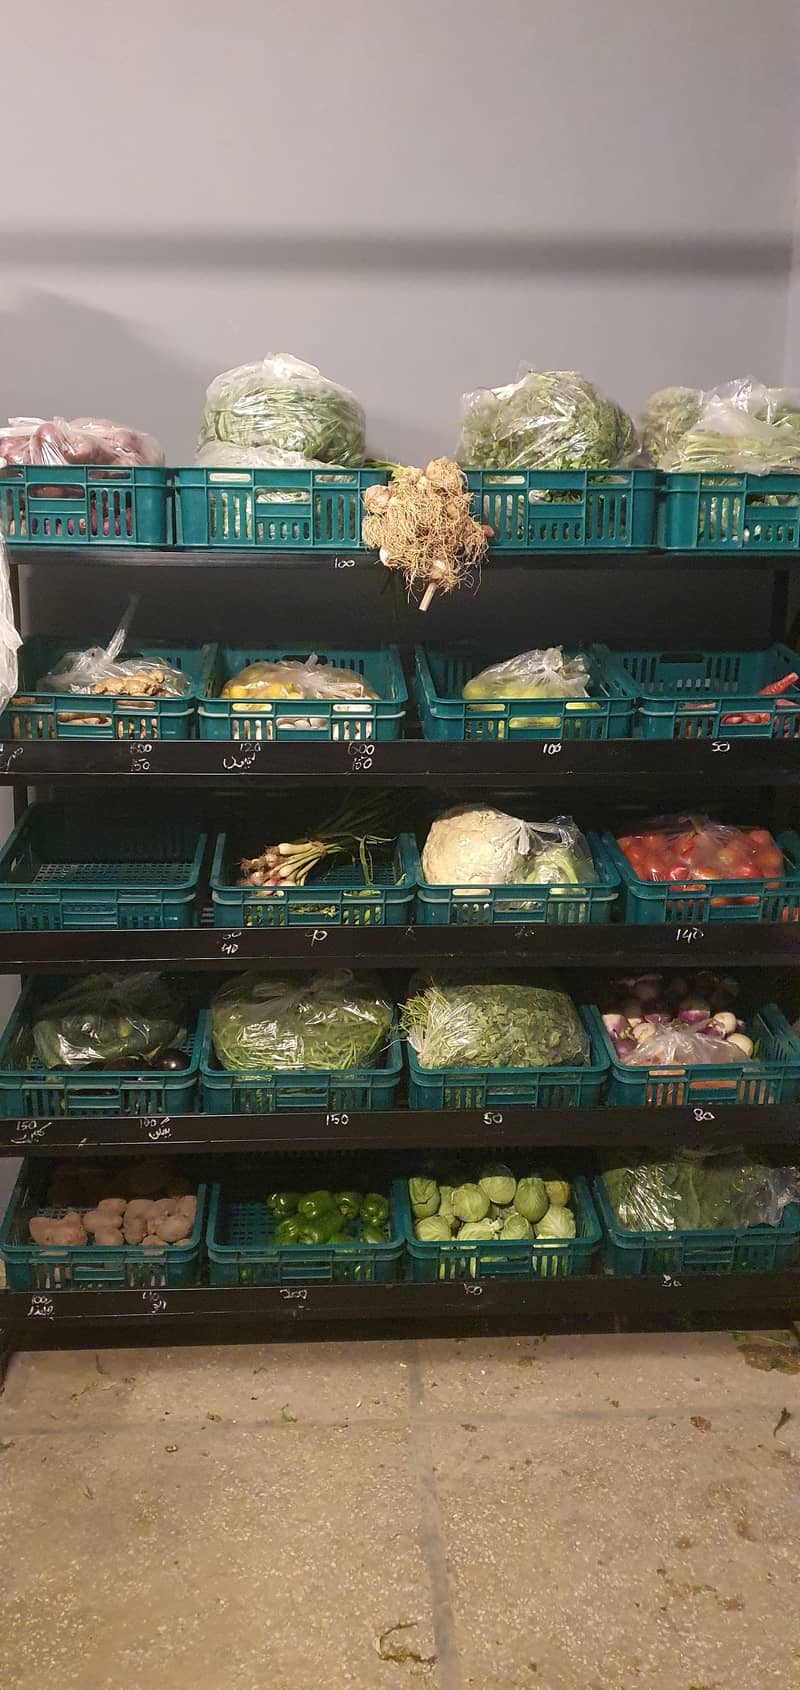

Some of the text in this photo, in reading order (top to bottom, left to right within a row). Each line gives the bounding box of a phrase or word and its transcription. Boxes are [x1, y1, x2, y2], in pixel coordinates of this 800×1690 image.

[335, 557, 356, 569] 100
[326, 1113, 350, 1126] 150
[483, 1112, 503, 1125] 50
